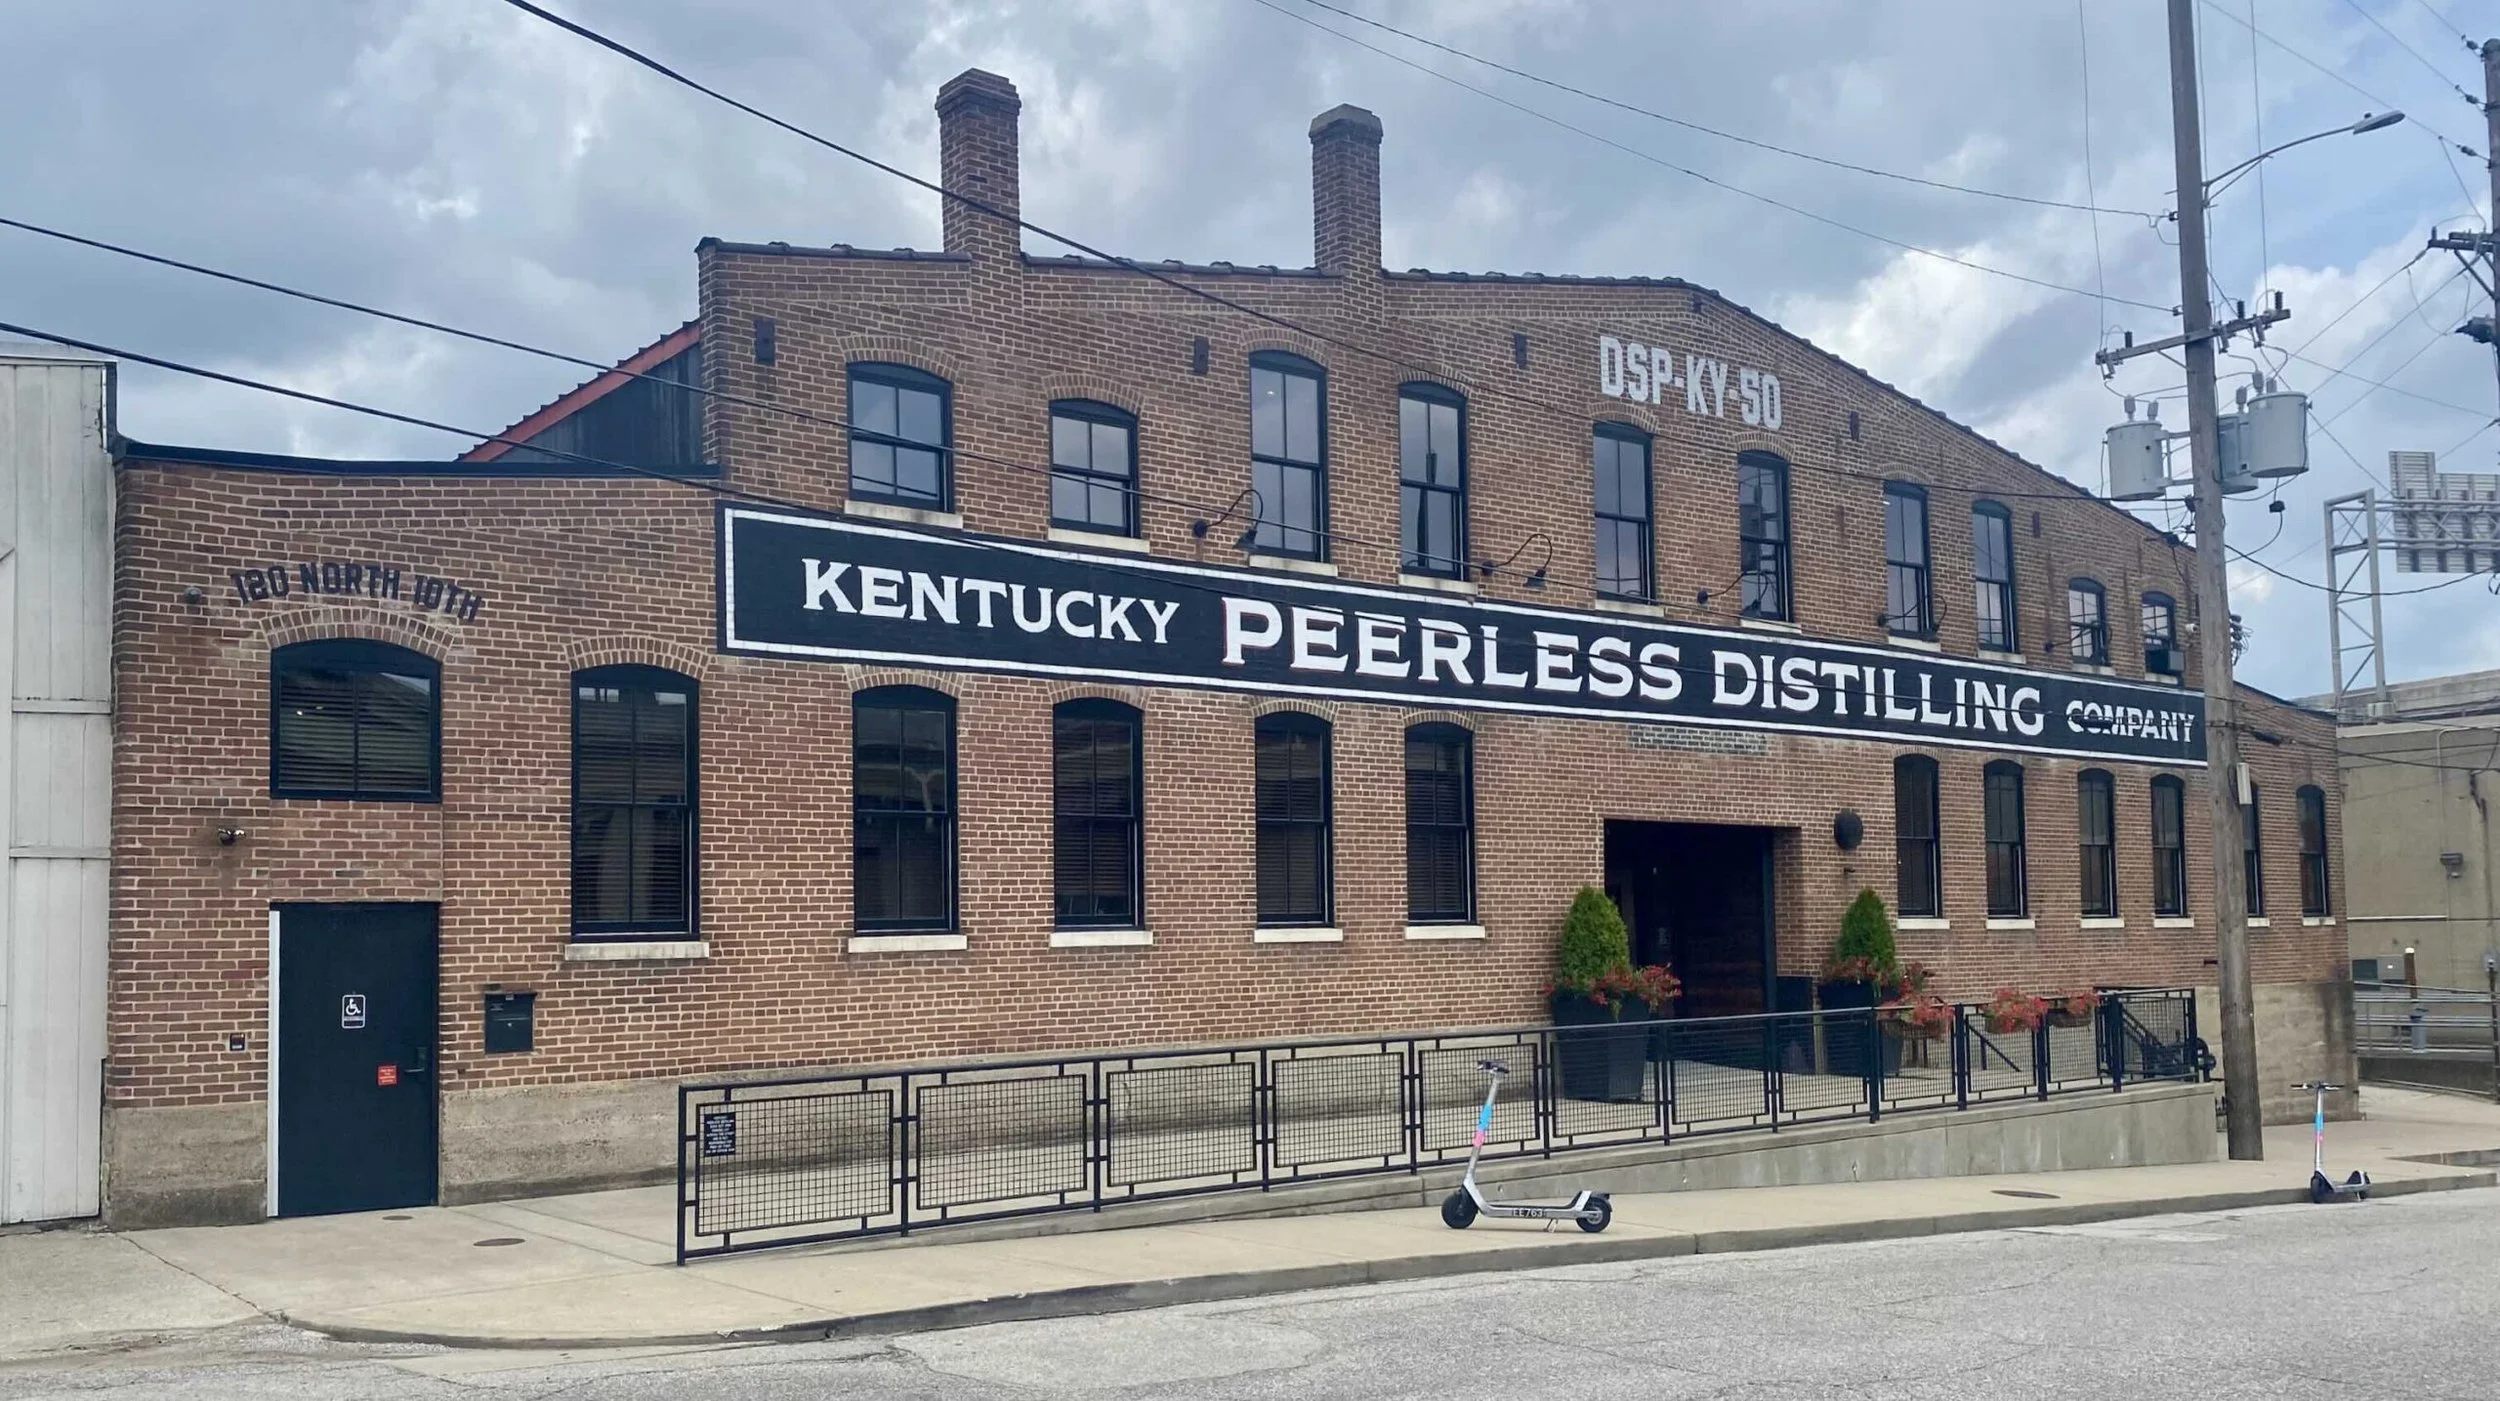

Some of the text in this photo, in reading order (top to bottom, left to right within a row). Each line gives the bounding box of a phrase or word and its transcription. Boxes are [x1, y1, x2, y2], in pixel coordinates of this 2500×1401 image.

[230, 562, 482, 622] 120 NORTH 10TH
[802, 557, 2196, 743] KENTUCKY PEERLESS DISTILLING COMPANY
